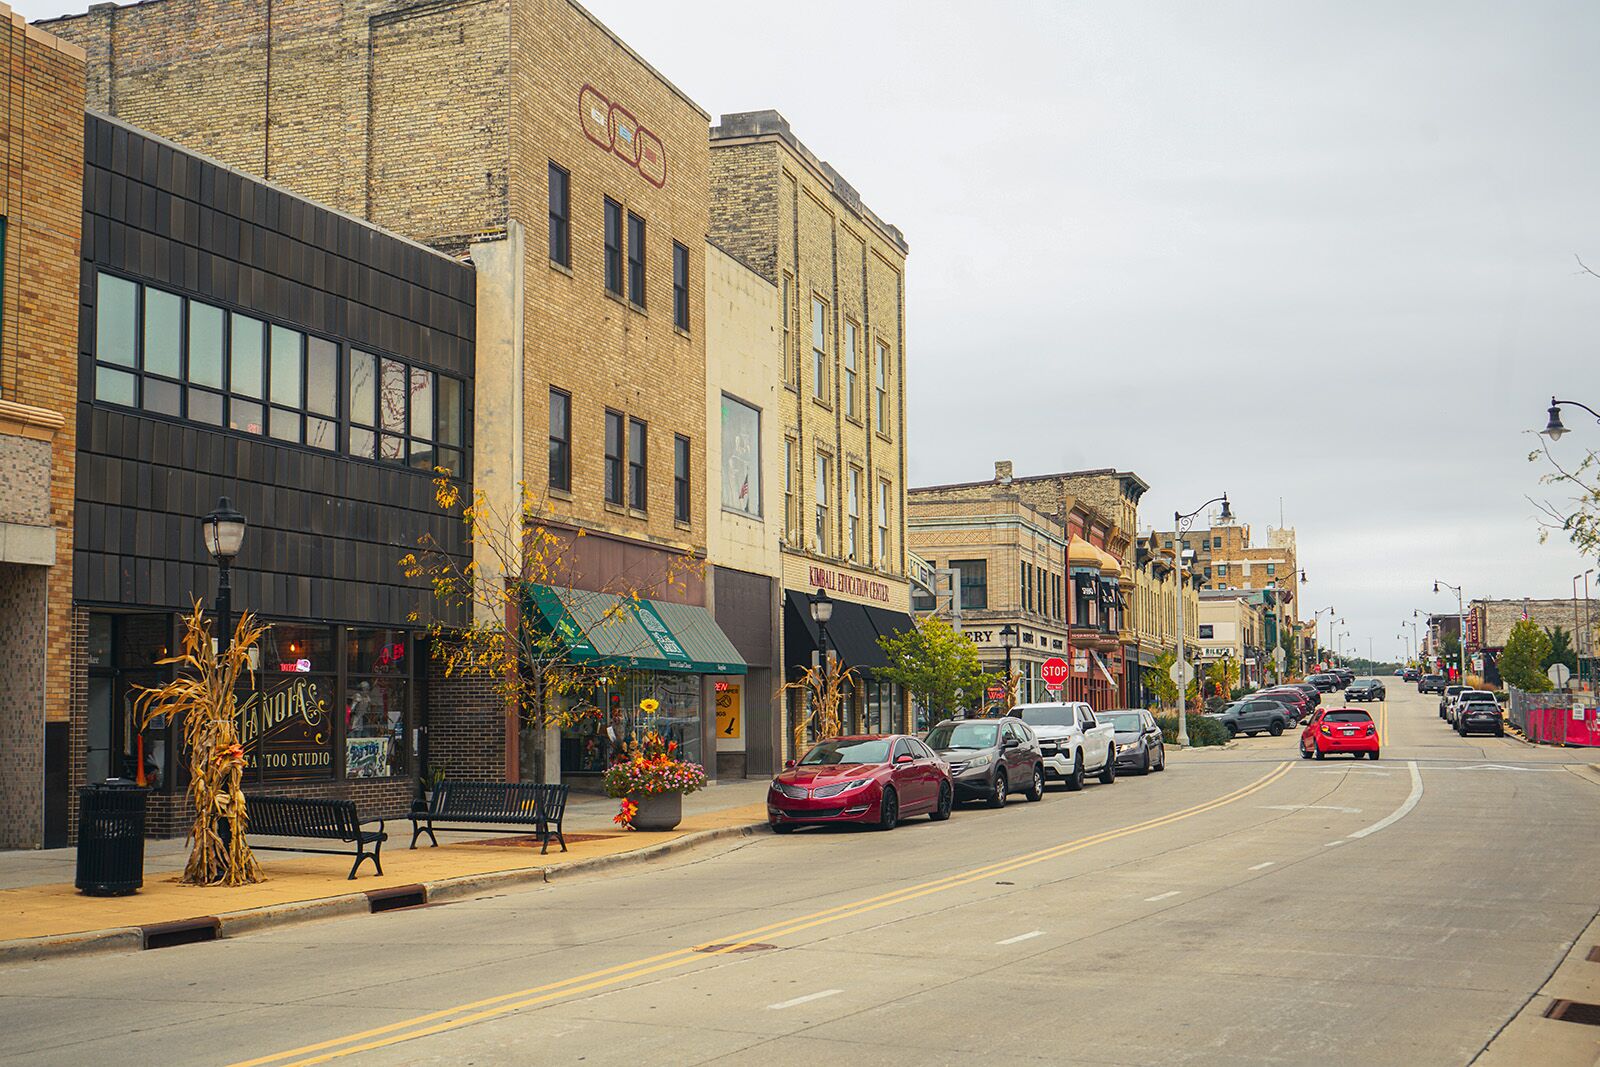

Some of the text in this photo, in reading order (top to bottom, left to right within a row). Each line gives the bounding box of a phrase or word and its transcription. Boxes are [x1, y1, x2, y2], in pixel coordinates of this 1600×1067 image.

[838, 573, 868, 597] EDUCATION
[870, 581, 889, 602] CENTER
[963, 630, 993, 643] ERY
[1043, 666, 1067, 677] STOP
[243, 751, 331, 768] TATOO STUDIO
